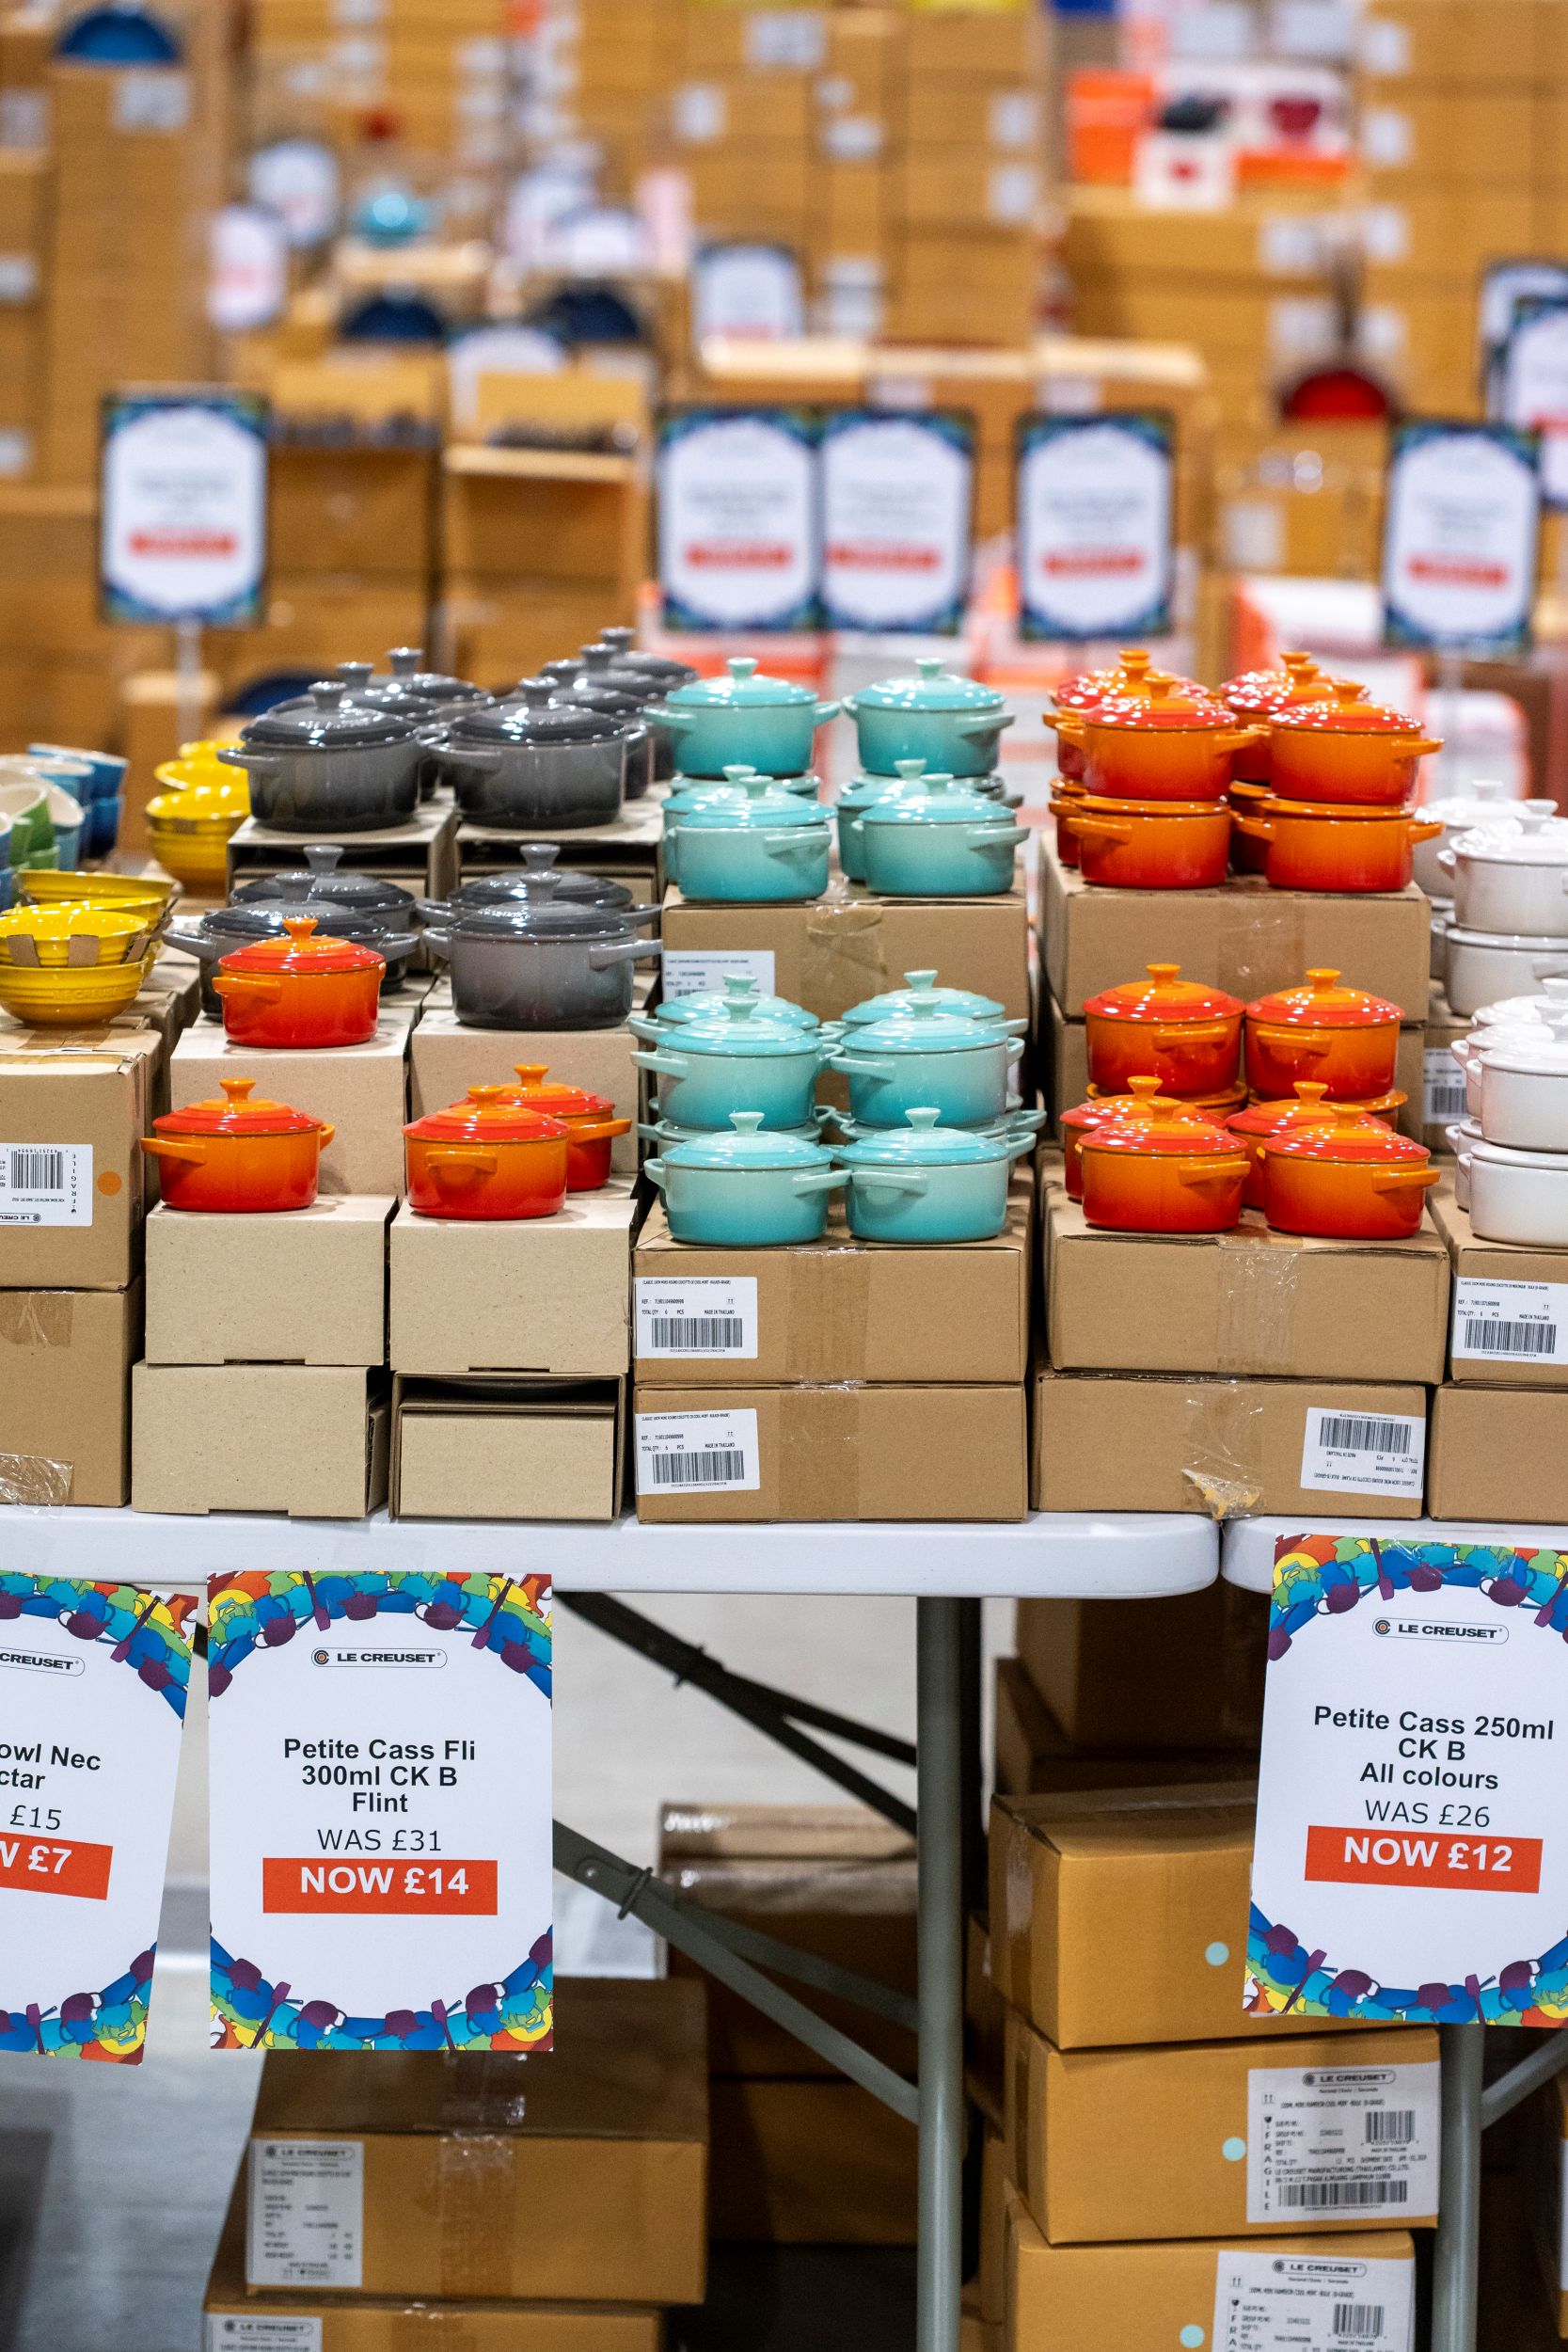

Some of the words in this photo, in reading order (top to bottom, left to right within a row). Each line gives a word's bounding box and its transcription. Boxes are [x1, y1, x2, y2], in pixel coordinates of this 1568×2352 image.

[1398, 1624, 1419, 1634] LE
[1422, 1626, 1497, 1638] CREUSET
[0, 1652, 73, 1670] CREUSET
[337, 1653, 357, 1662] LE
[361, 1653, 435, 1663] CREUSET
[1314, 1705, 1390, 1730] Petite
[1399, 1711, 1465, 1735] Cass
[1473, 1716, 1553, 1740] 250ml
[51, 1745, 101, 1771] Nec
[284, 1739, 359, 1759] Petite
[369, 1739, 434, 1760] Cass
[445, 1740, 475, 1760] Fli
[1398, 1738, 1438, 1760] CK
[1447, 1741, 1466, 1761] B
[302, 1765, 380, 1785] 300ml
[390, 1766, 430, 1786] CK
[439, 1767, 457, 1786] B
[1360, 1762, 1394, 1783] All
[1403, 1767, 1498, 1789] colours
[352, 1792, 408, 1812] Flint
[1365, 1799, 1428, 1823] WAS
[1439, 1804, 1490, 1828] £26
[10, 1805, 62, 1830] £15
[317, 1829, 381, 1851] WAS
[392, 1830, 441, 1851] £31
[28, 1845, 72, 1874] £7
[1344, 1836, 1439, 1868] NOW
[1447, 1842, 1513, 1872] £12
[301, 1867, 394, 1894] NOW
[404, 1868, 469, 1895] £14
[1307, 2265, 1358, 2273] CREUSET
[1229, 2315, 1237, 2352] FRA
